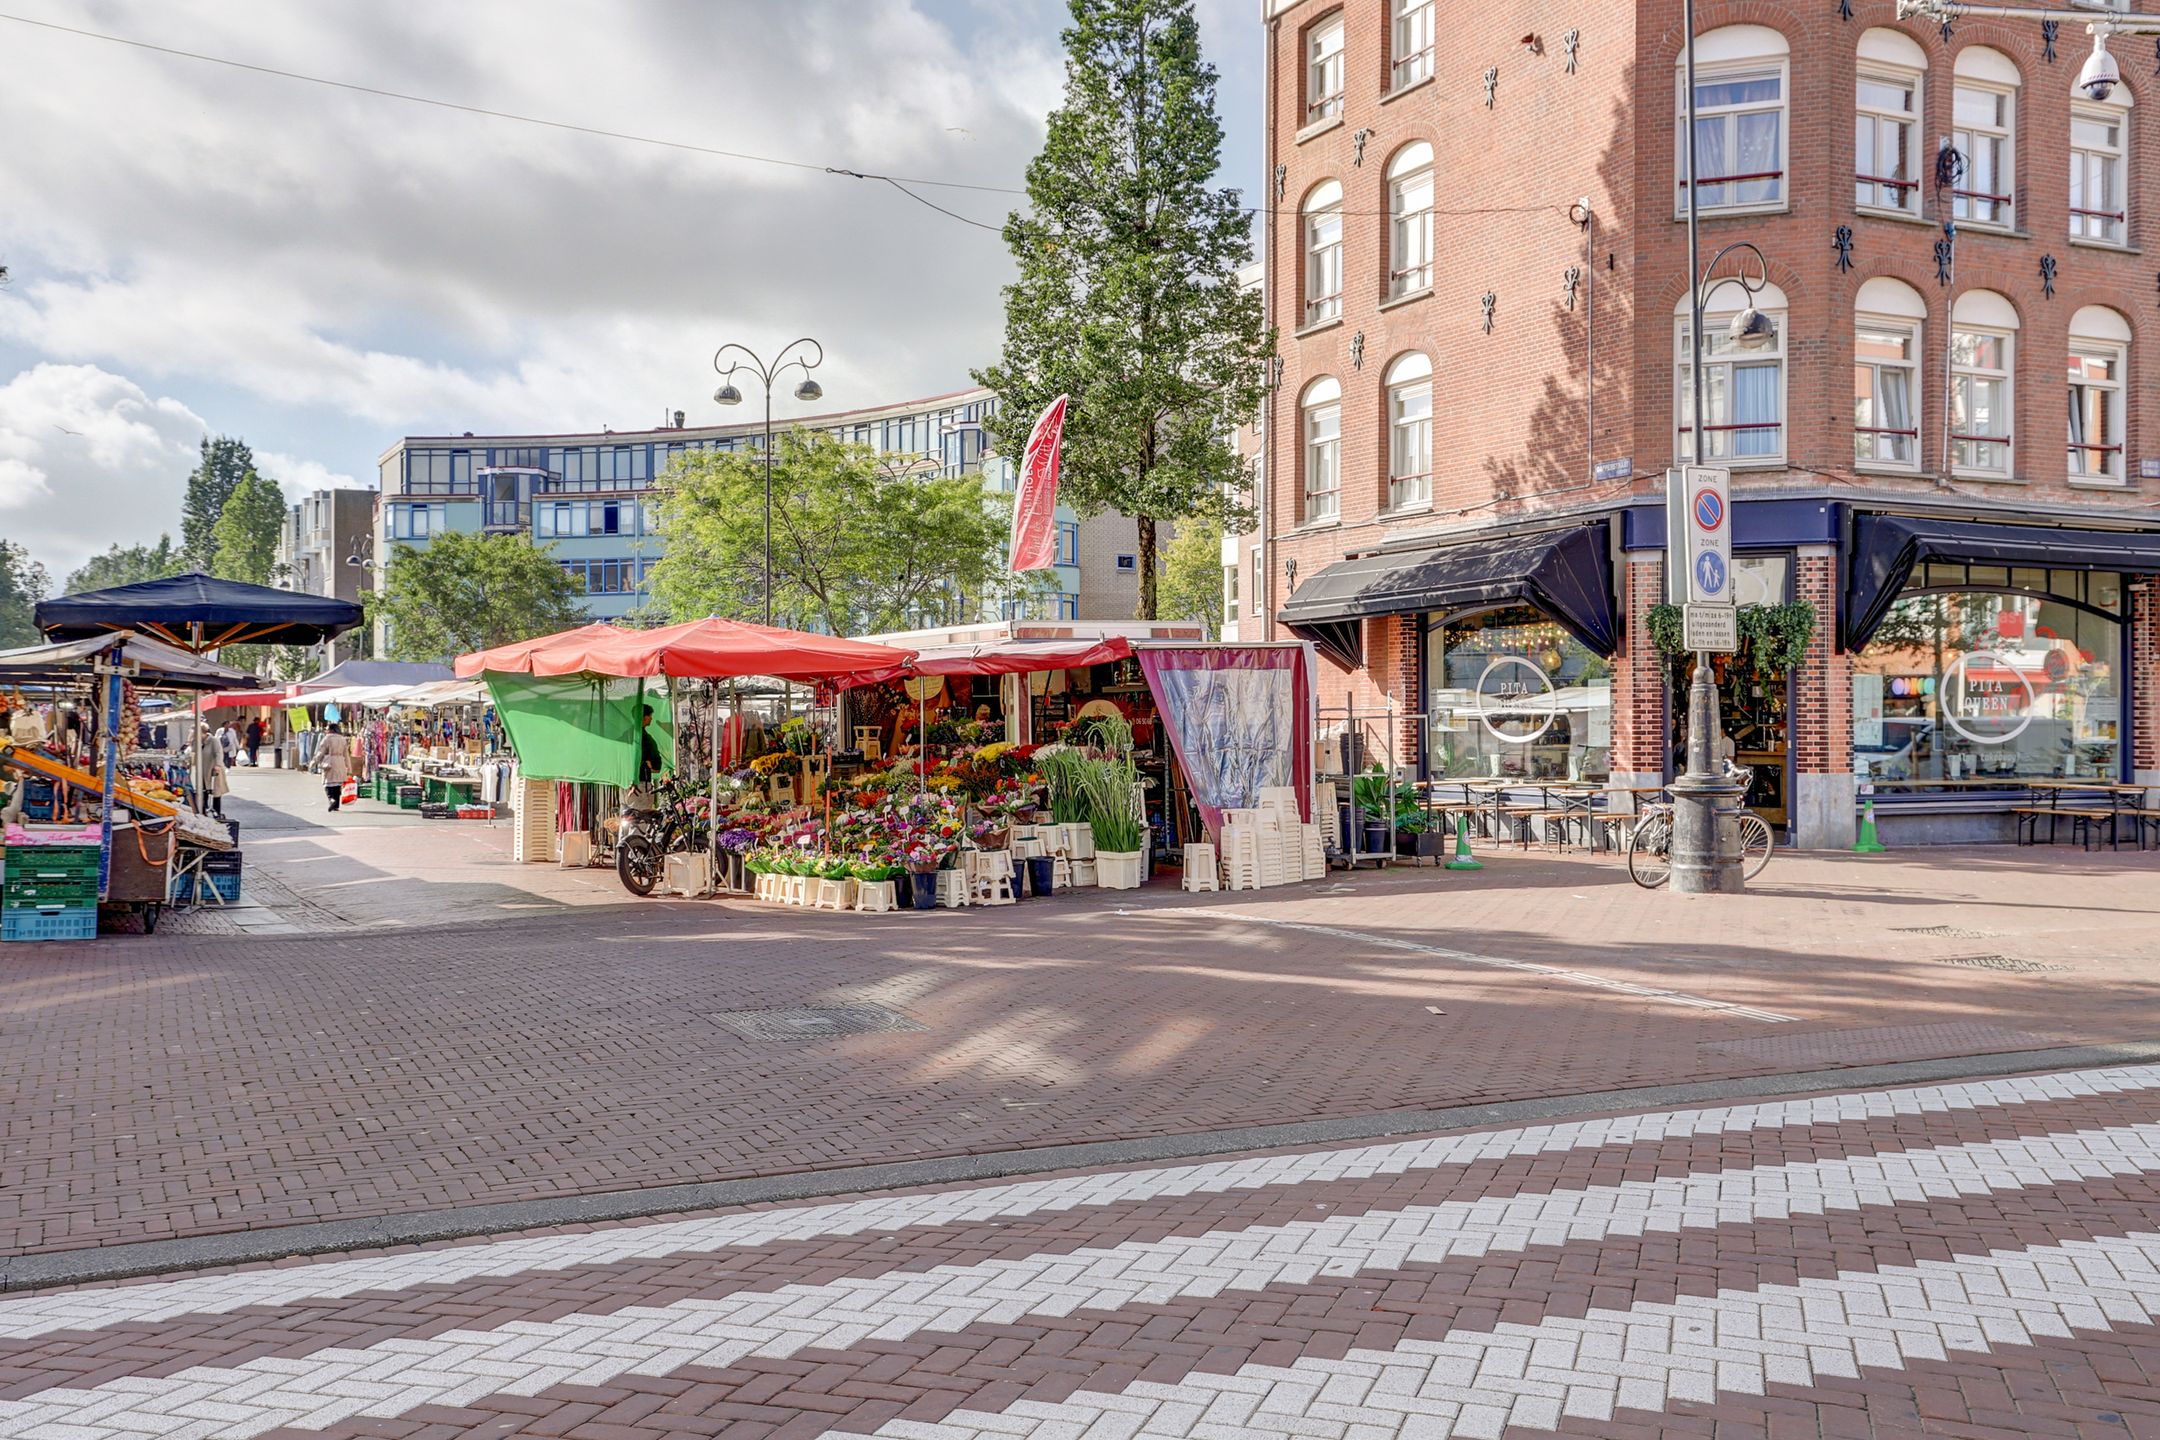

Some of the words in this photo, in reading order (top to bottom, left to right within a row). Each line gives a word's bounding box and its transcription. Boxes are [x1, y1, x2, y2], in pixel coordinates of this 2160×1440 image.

[1698, 474, 1718, 483] ZONE
[1700, 539, 1720, 547] ZONE
[1500, 682, 1528, 694] PITA
[1969, 680, 2003, 692] PITA
[1965, 697, 2008, 712] QUEEN
